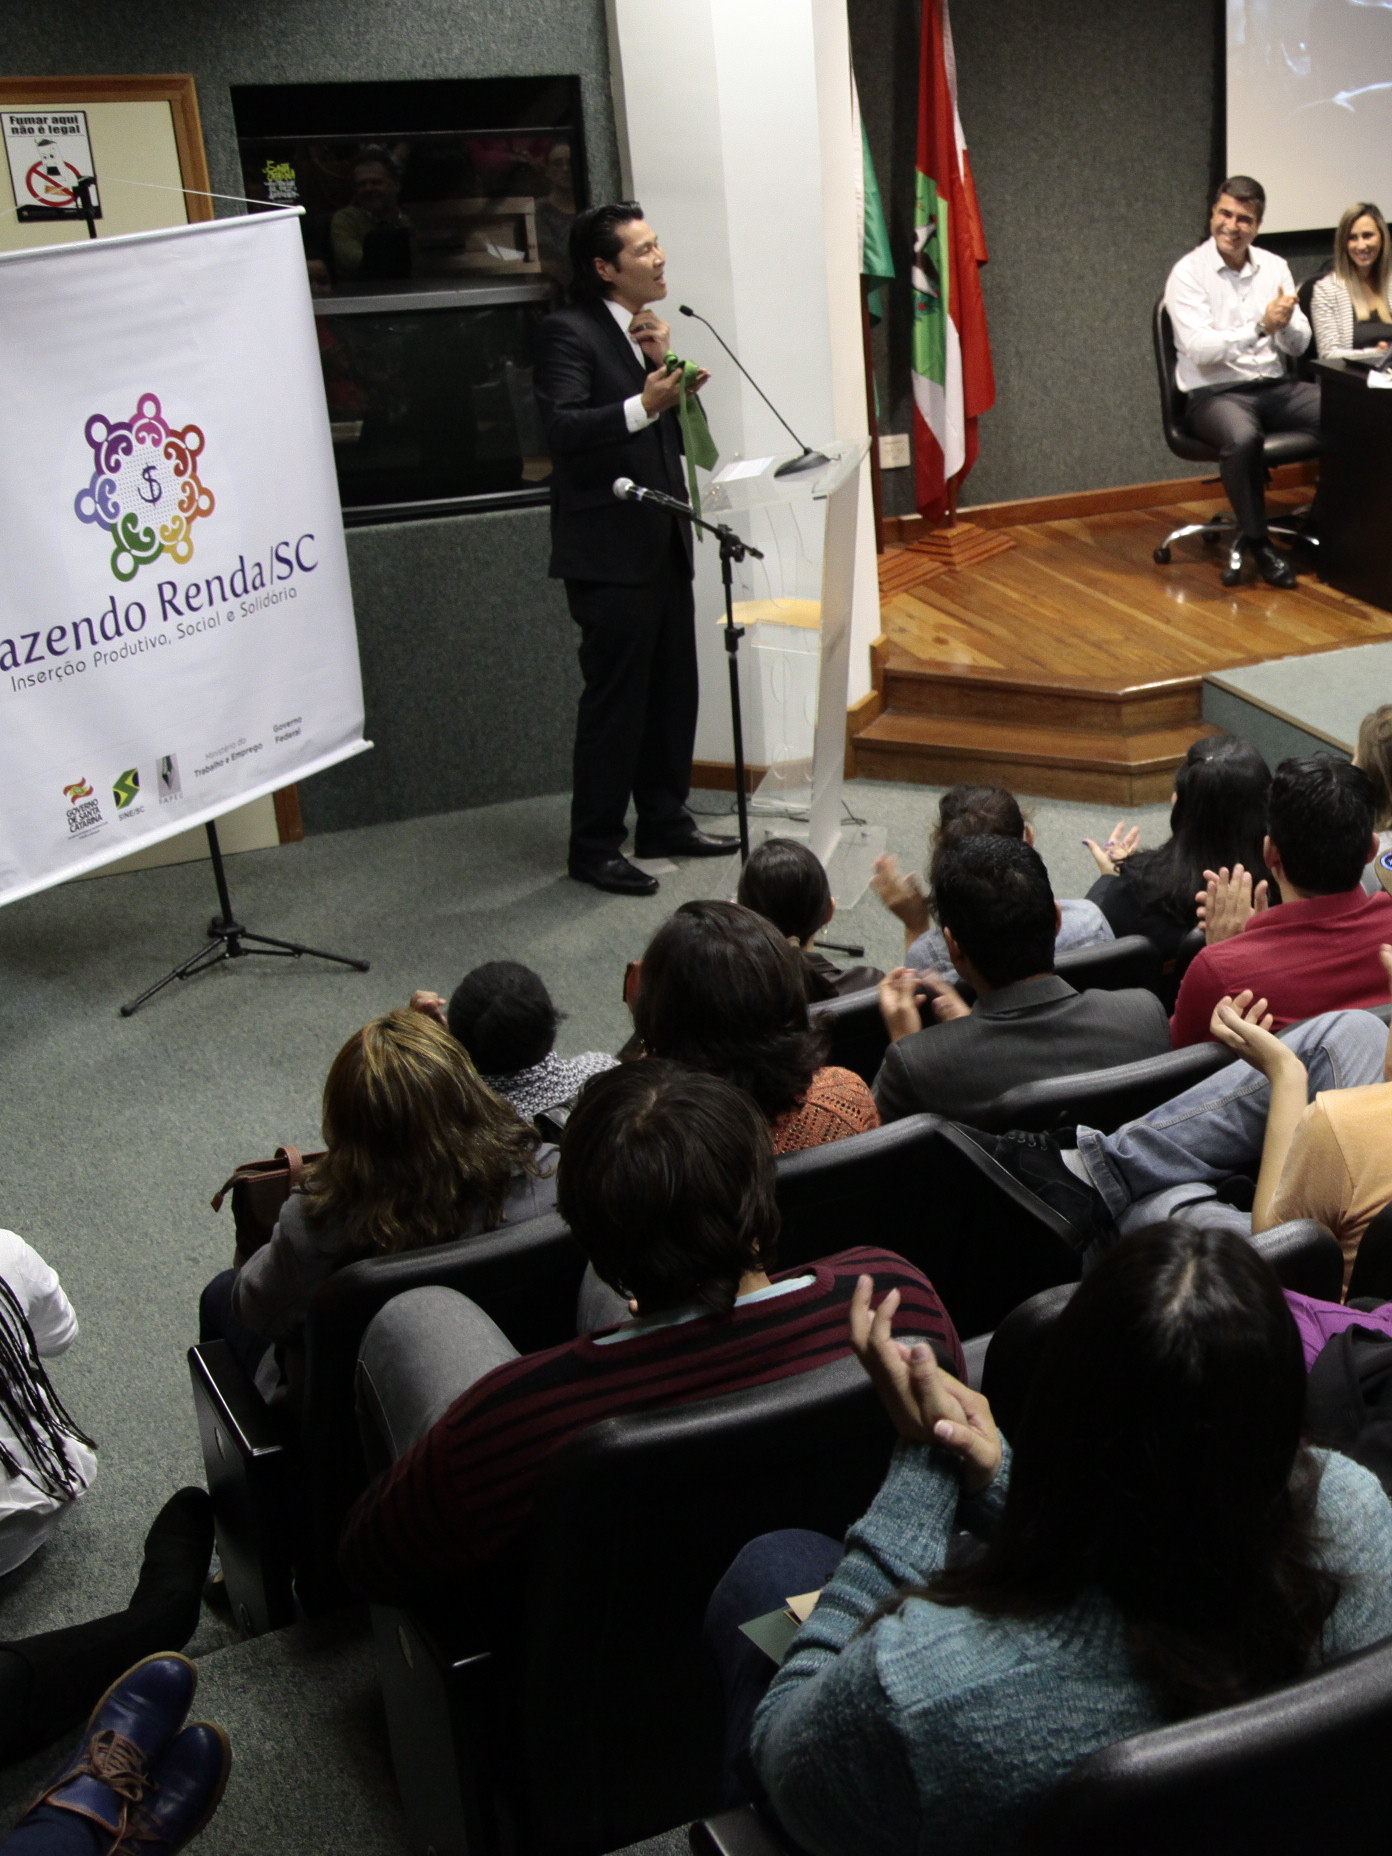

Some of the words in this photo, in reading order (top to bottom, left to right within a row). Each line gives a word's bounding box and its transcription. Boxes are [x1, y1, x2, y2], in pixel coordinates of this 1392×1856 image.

[9, 115, 48, 125] Fumar
[51, 115, 79, 126] aqui
[11, 125, 35, 135] não
[37, 125, 46, 135] é
[48, 125, 81, 135] legal
[157, 533, 319, 622] Renda/SC
[11, 660, 87, 692] Inserção
[93, 633, 171, 668] Produtiva,
[176, 610, 221, 640] Social
[226, 610, 236, 622] e
[240, 587, 297, 618] Solidário
[273, 716, 302, 733] Governo
[275, 727, 302, 743] Federal
[66, 798, 99, 818] GOVERNO
[67, 814, 79, 826] DE
[78, 806, 100, 821] SANTA
[118, 806, 145, 821] SINE/SC
[69, 815, 103, 833] CATARINA
